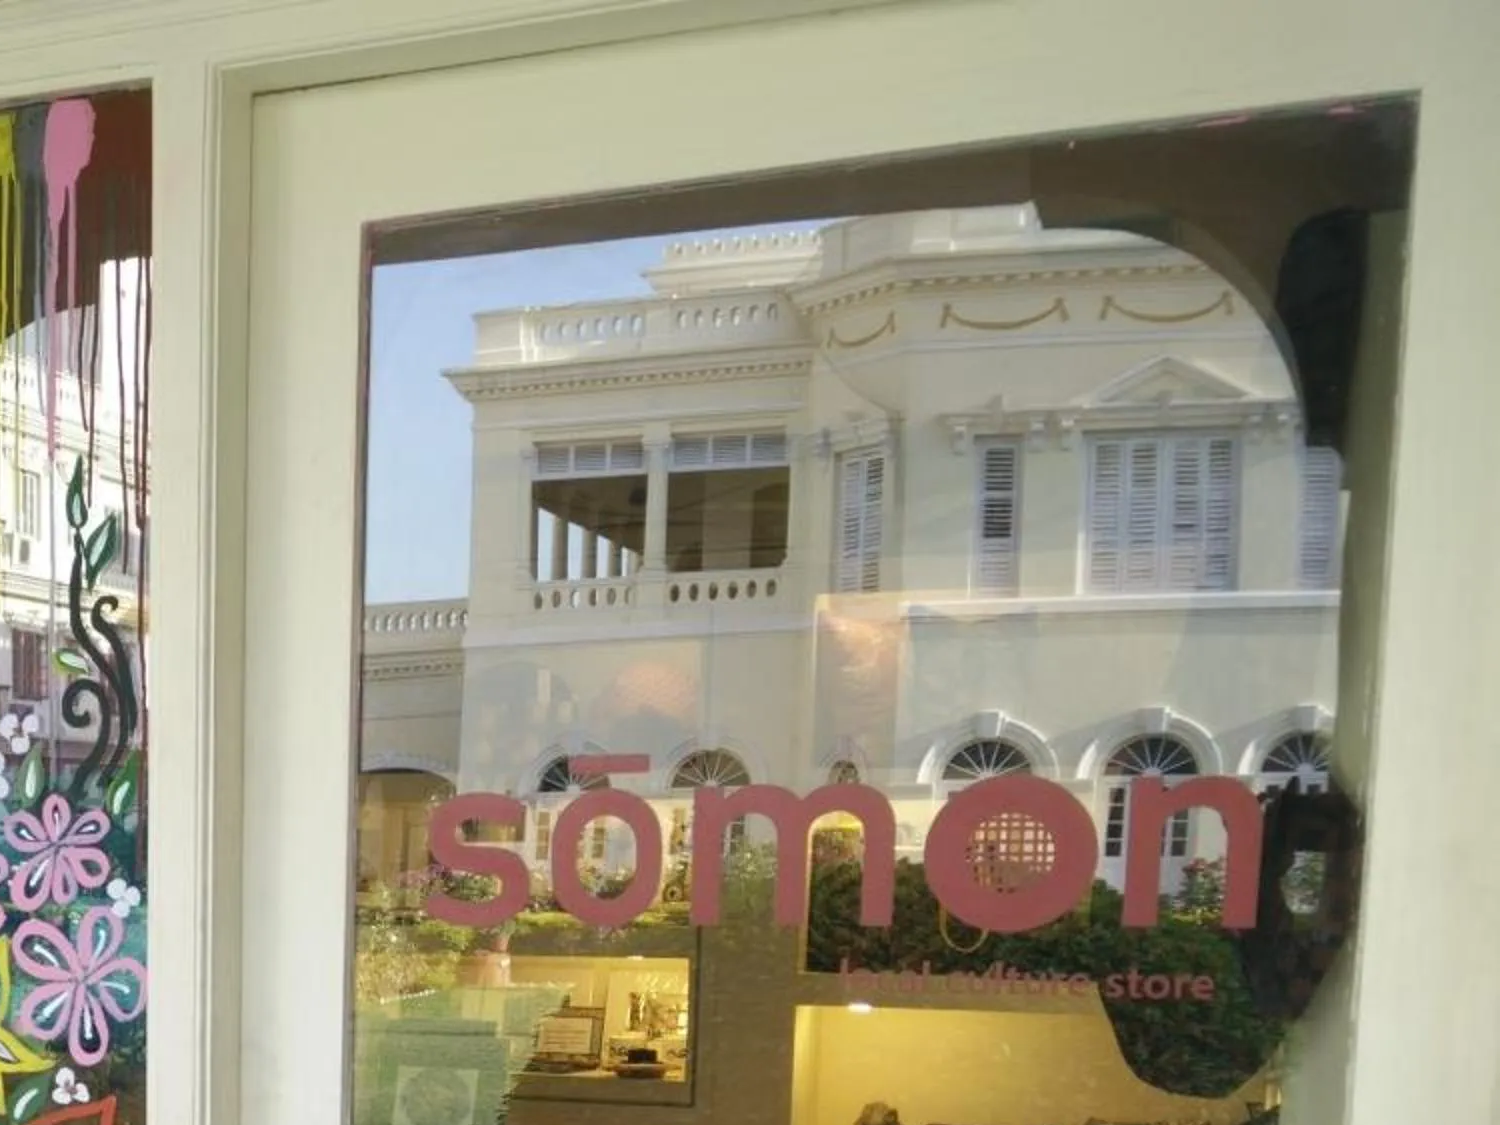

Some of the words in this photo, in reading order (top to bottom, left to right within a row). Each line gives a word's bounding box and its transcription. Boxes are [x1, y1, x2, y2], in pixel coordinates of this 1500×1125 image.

[838, 957, 930, 993] local
[950, 961, 1092, 999] culture
[1106, 968, 1216, 1001] store
